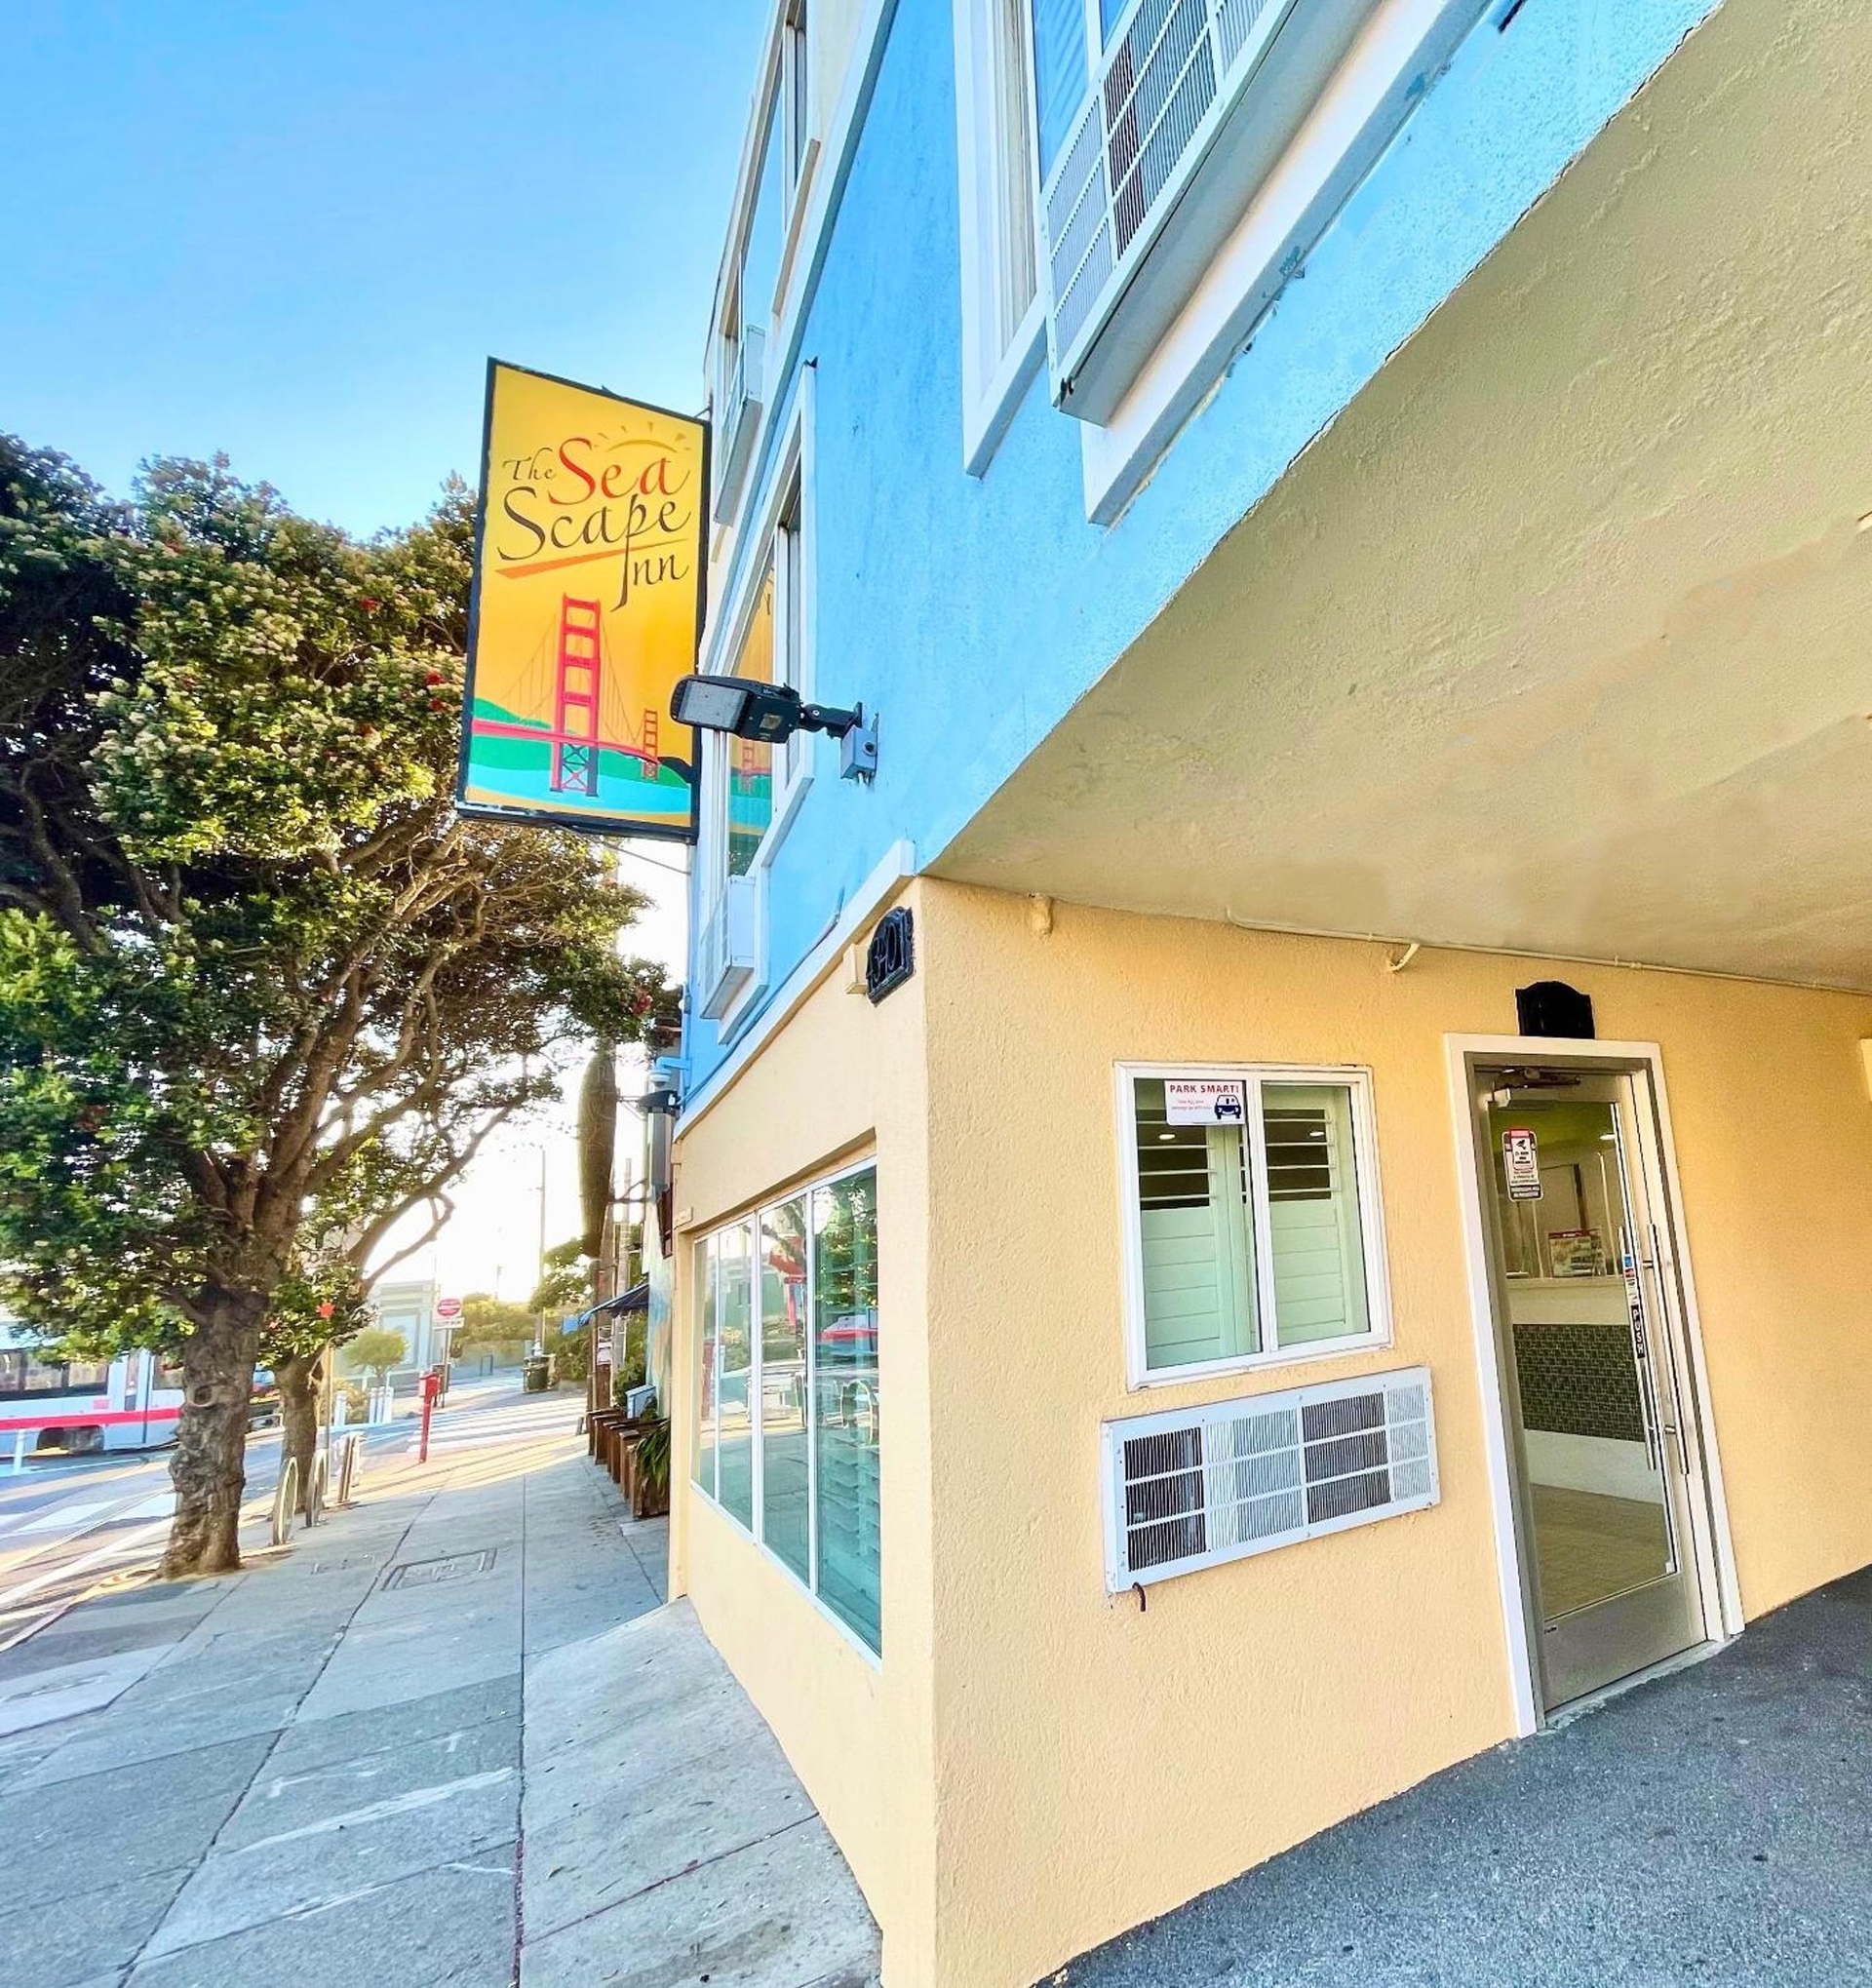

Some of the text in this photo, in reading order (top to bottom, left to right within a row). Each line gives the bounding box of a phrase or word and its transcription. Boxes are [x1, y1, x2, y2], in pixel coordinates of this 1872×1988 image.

[502, 437, 691, 506] The Sea
[497, 486, 691, 562] Scape
[610, 550, 689, 612] Inn
[1169, 1084, 1239, 1093] PARK SMART!
